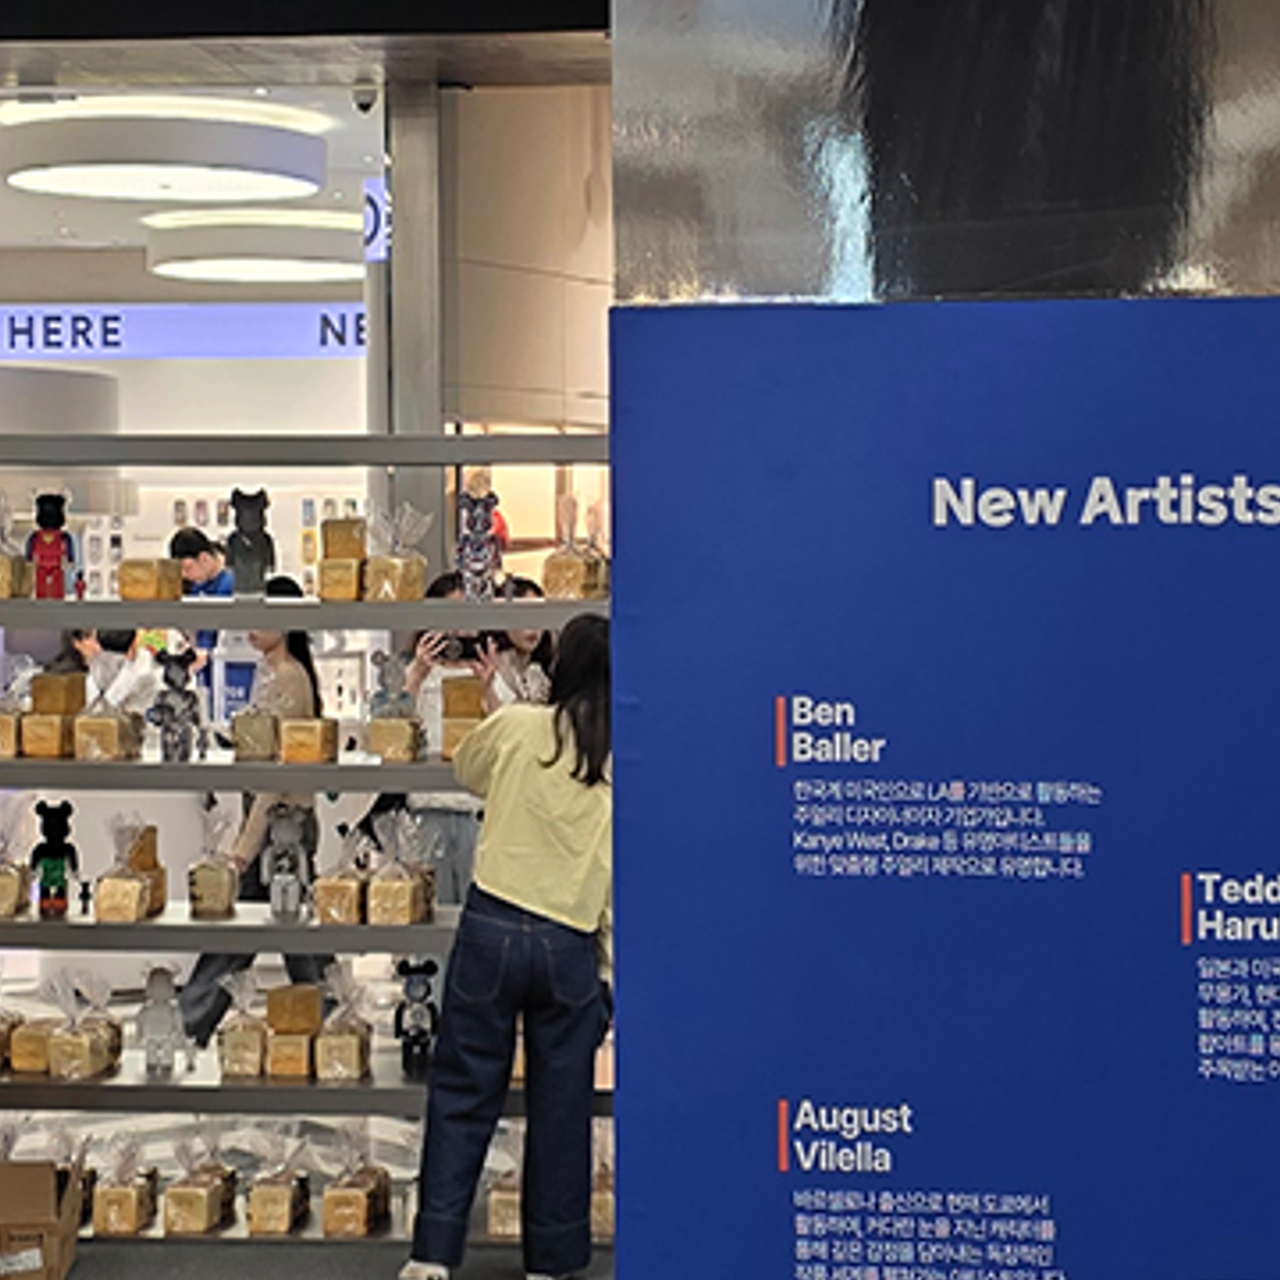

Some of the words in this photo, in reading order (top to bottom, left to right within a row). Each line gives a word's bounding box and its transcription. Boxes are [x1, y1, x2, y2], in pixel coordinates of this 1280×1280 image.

[8, 315, 122, 348] HERE
[933, 477, 1067, 526] New
[792, 696, 855, 726] Ben
[792, 732, 886, 763] Baller
[793, 1099, 913, 1139] August
[794, 1140, 891, 1172] Vilella
